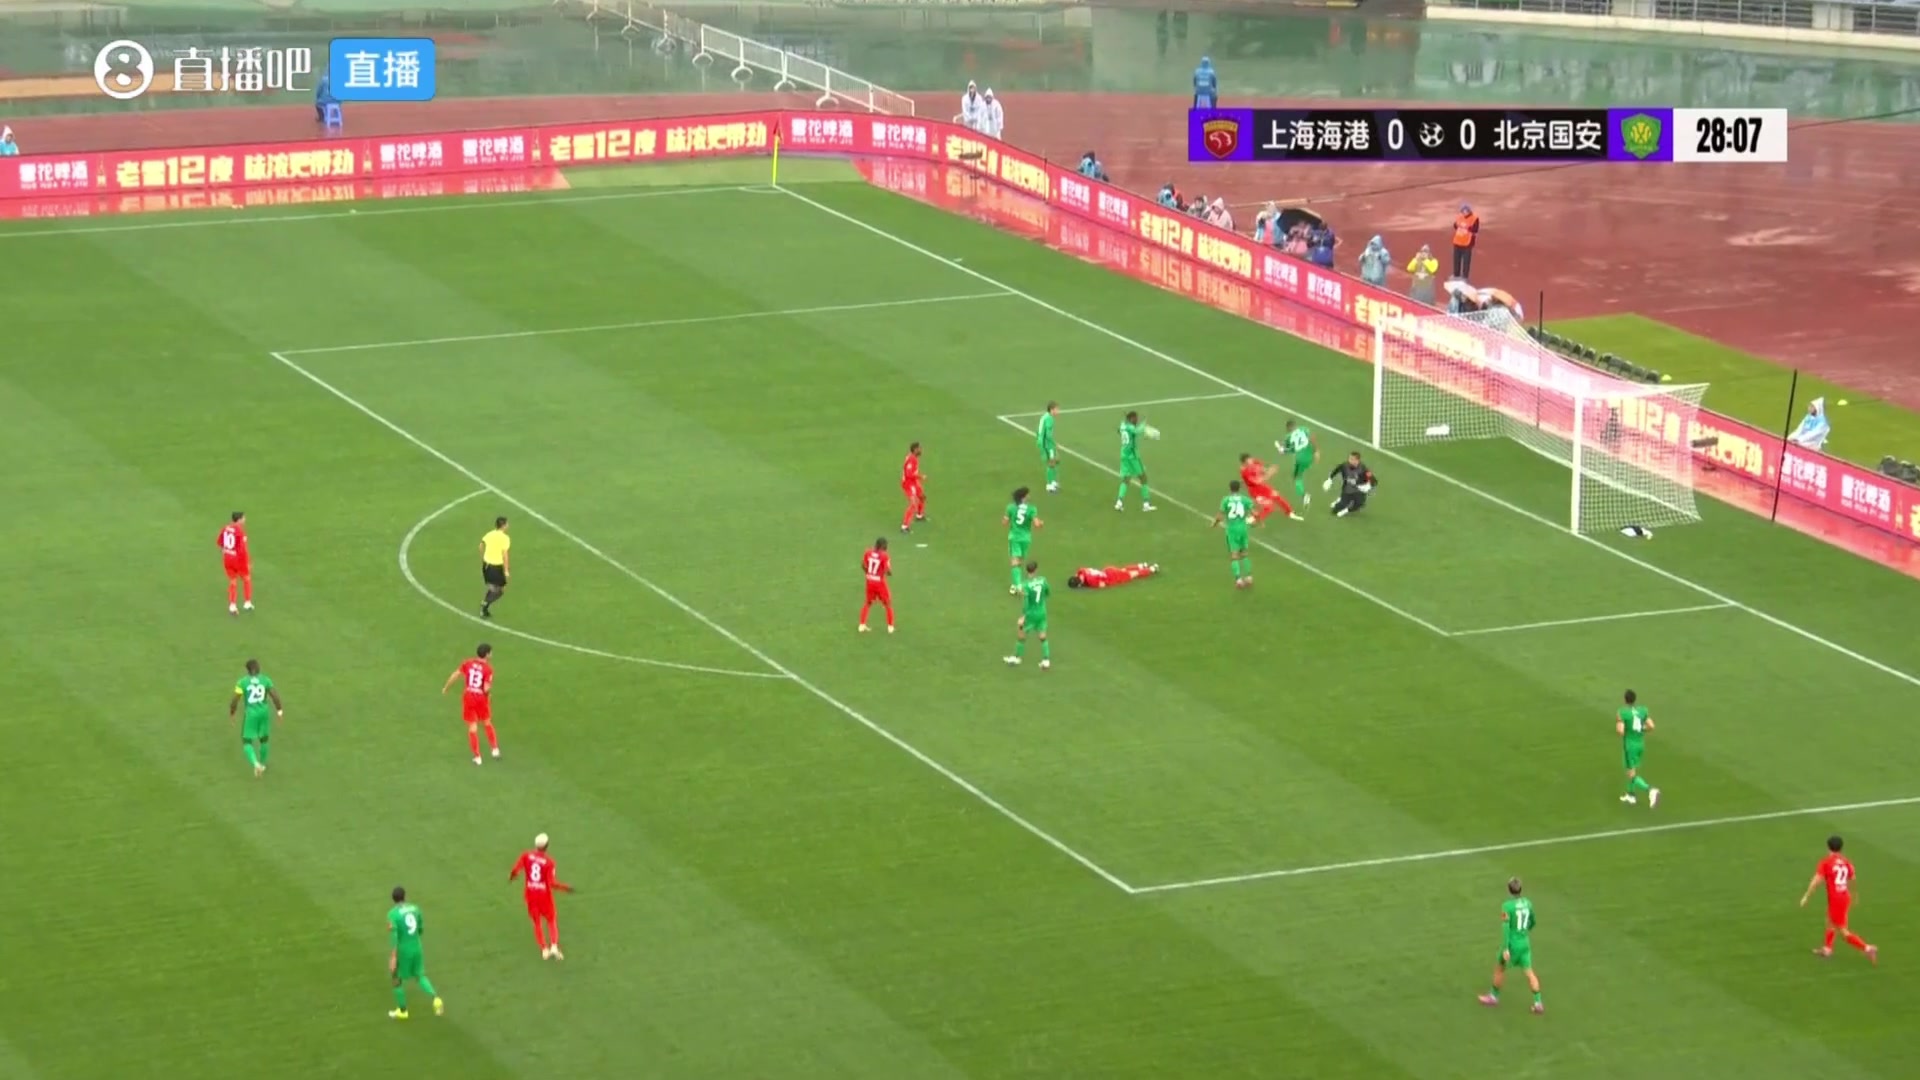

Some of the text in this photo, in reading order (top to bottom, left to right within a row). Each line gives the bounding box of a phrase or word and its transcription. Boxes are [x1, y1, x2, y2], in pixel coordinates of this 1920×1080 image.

[1016, 508, 1026, 525] 5
[1228, 502, 1245, 519] 24
[223, 531, 235, 550] 10
[868, 557, 881, 574] 17
[1033, 585, 1042, 603] 7
[468, 669, 483, 688] 13
[247, 684, 266, 704] 29
[1631, 717, 1643, 733] 4
[529, 865, 541, 882] 8
[405, 914, 417, 934] 9
[1515, 908, 1529, 930] 17
